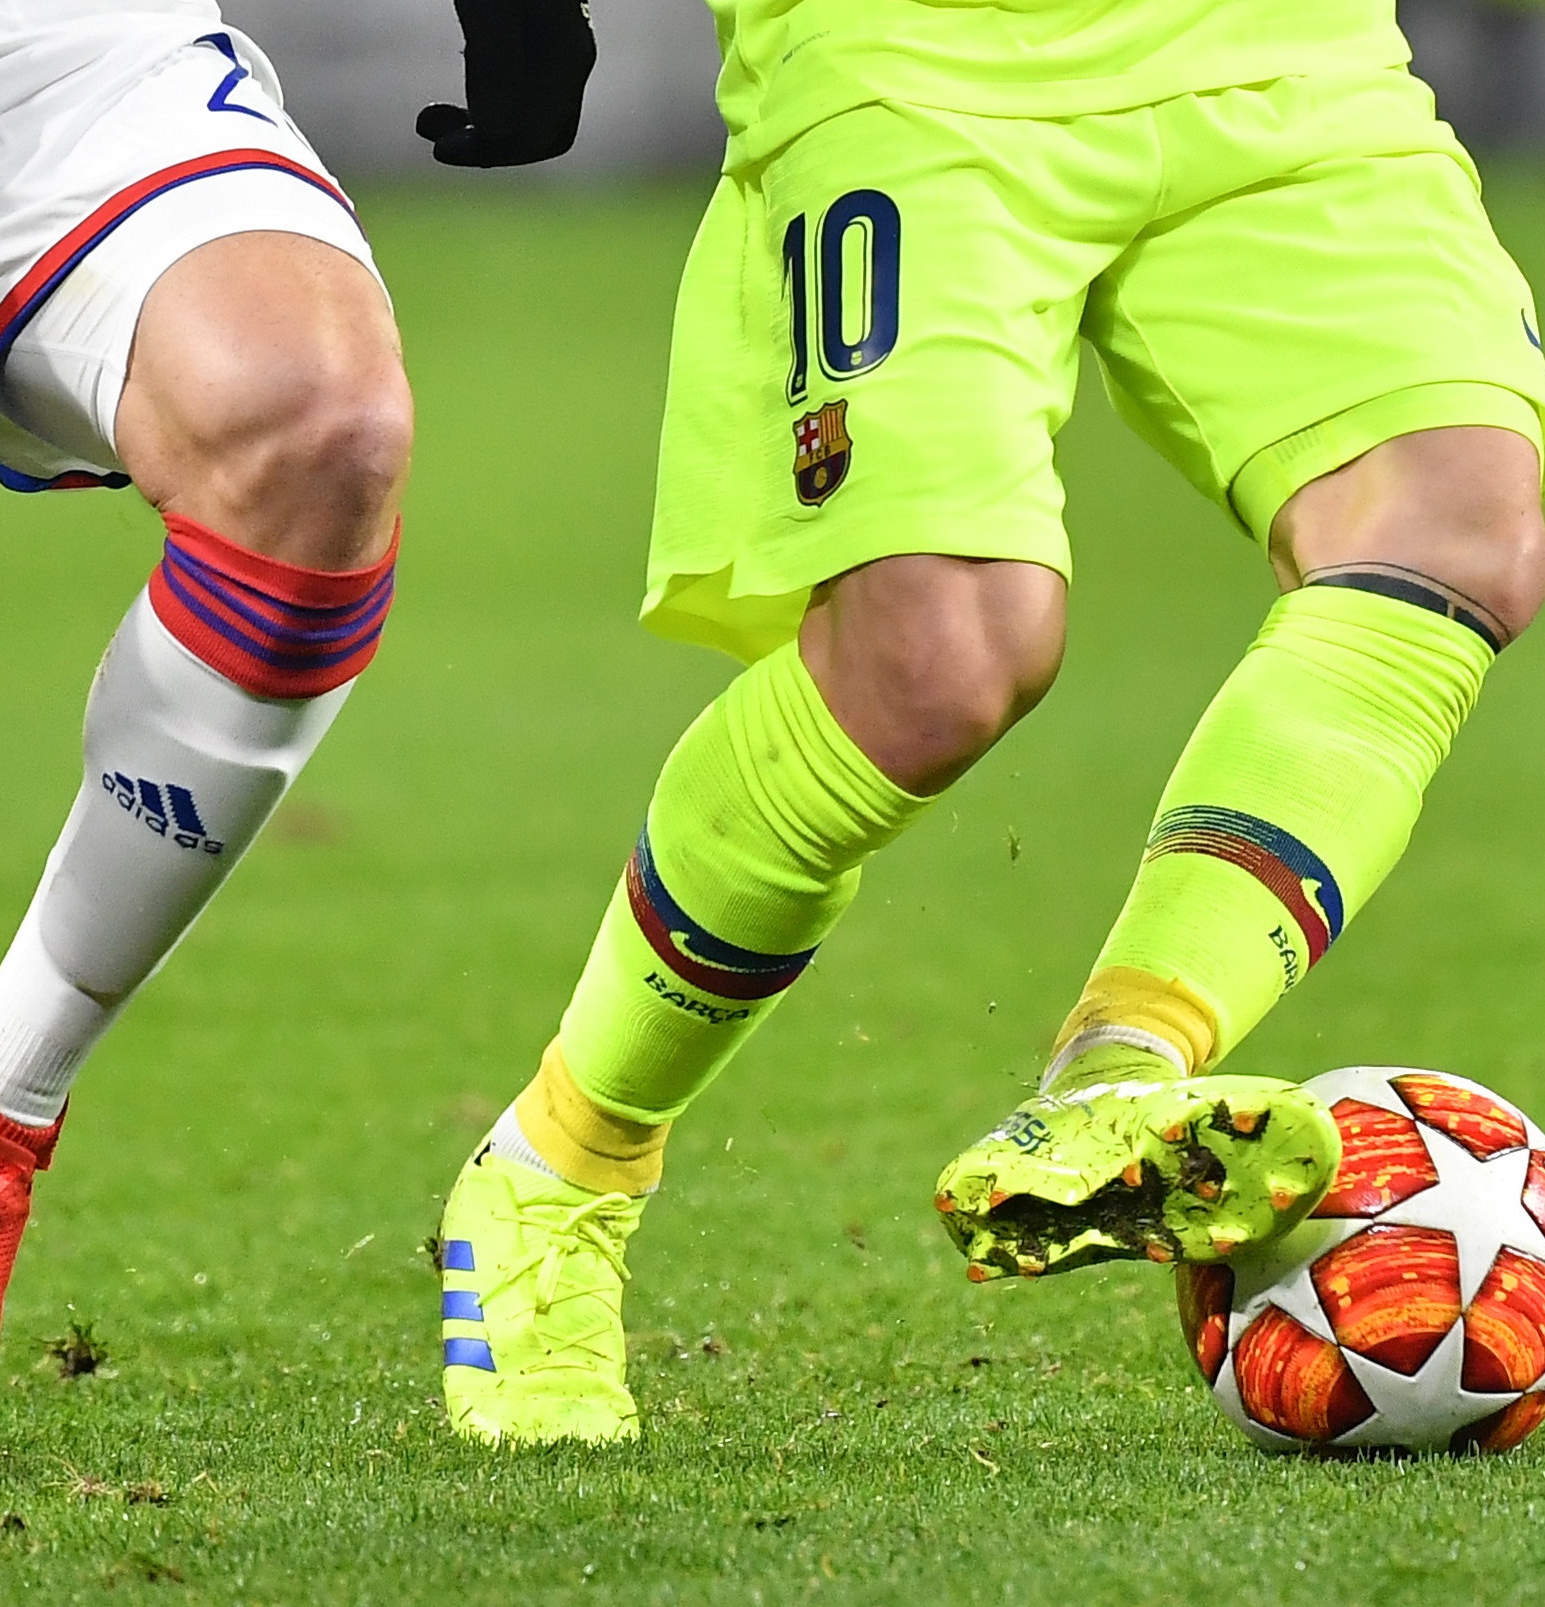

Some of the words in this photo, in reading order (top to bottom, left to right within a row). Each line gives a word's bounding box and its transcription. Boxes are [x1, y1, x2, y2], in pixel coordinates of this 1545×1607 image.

[192, 32, 279, 128] 2
[781, 188, 901, 408] 10
[809, 444, 831, 464] FCB
[102, 772, 224, 855] adidas
[644, 971, 750, 1024] BARÇA
[1268, 925, 1298, 1000] BAR
